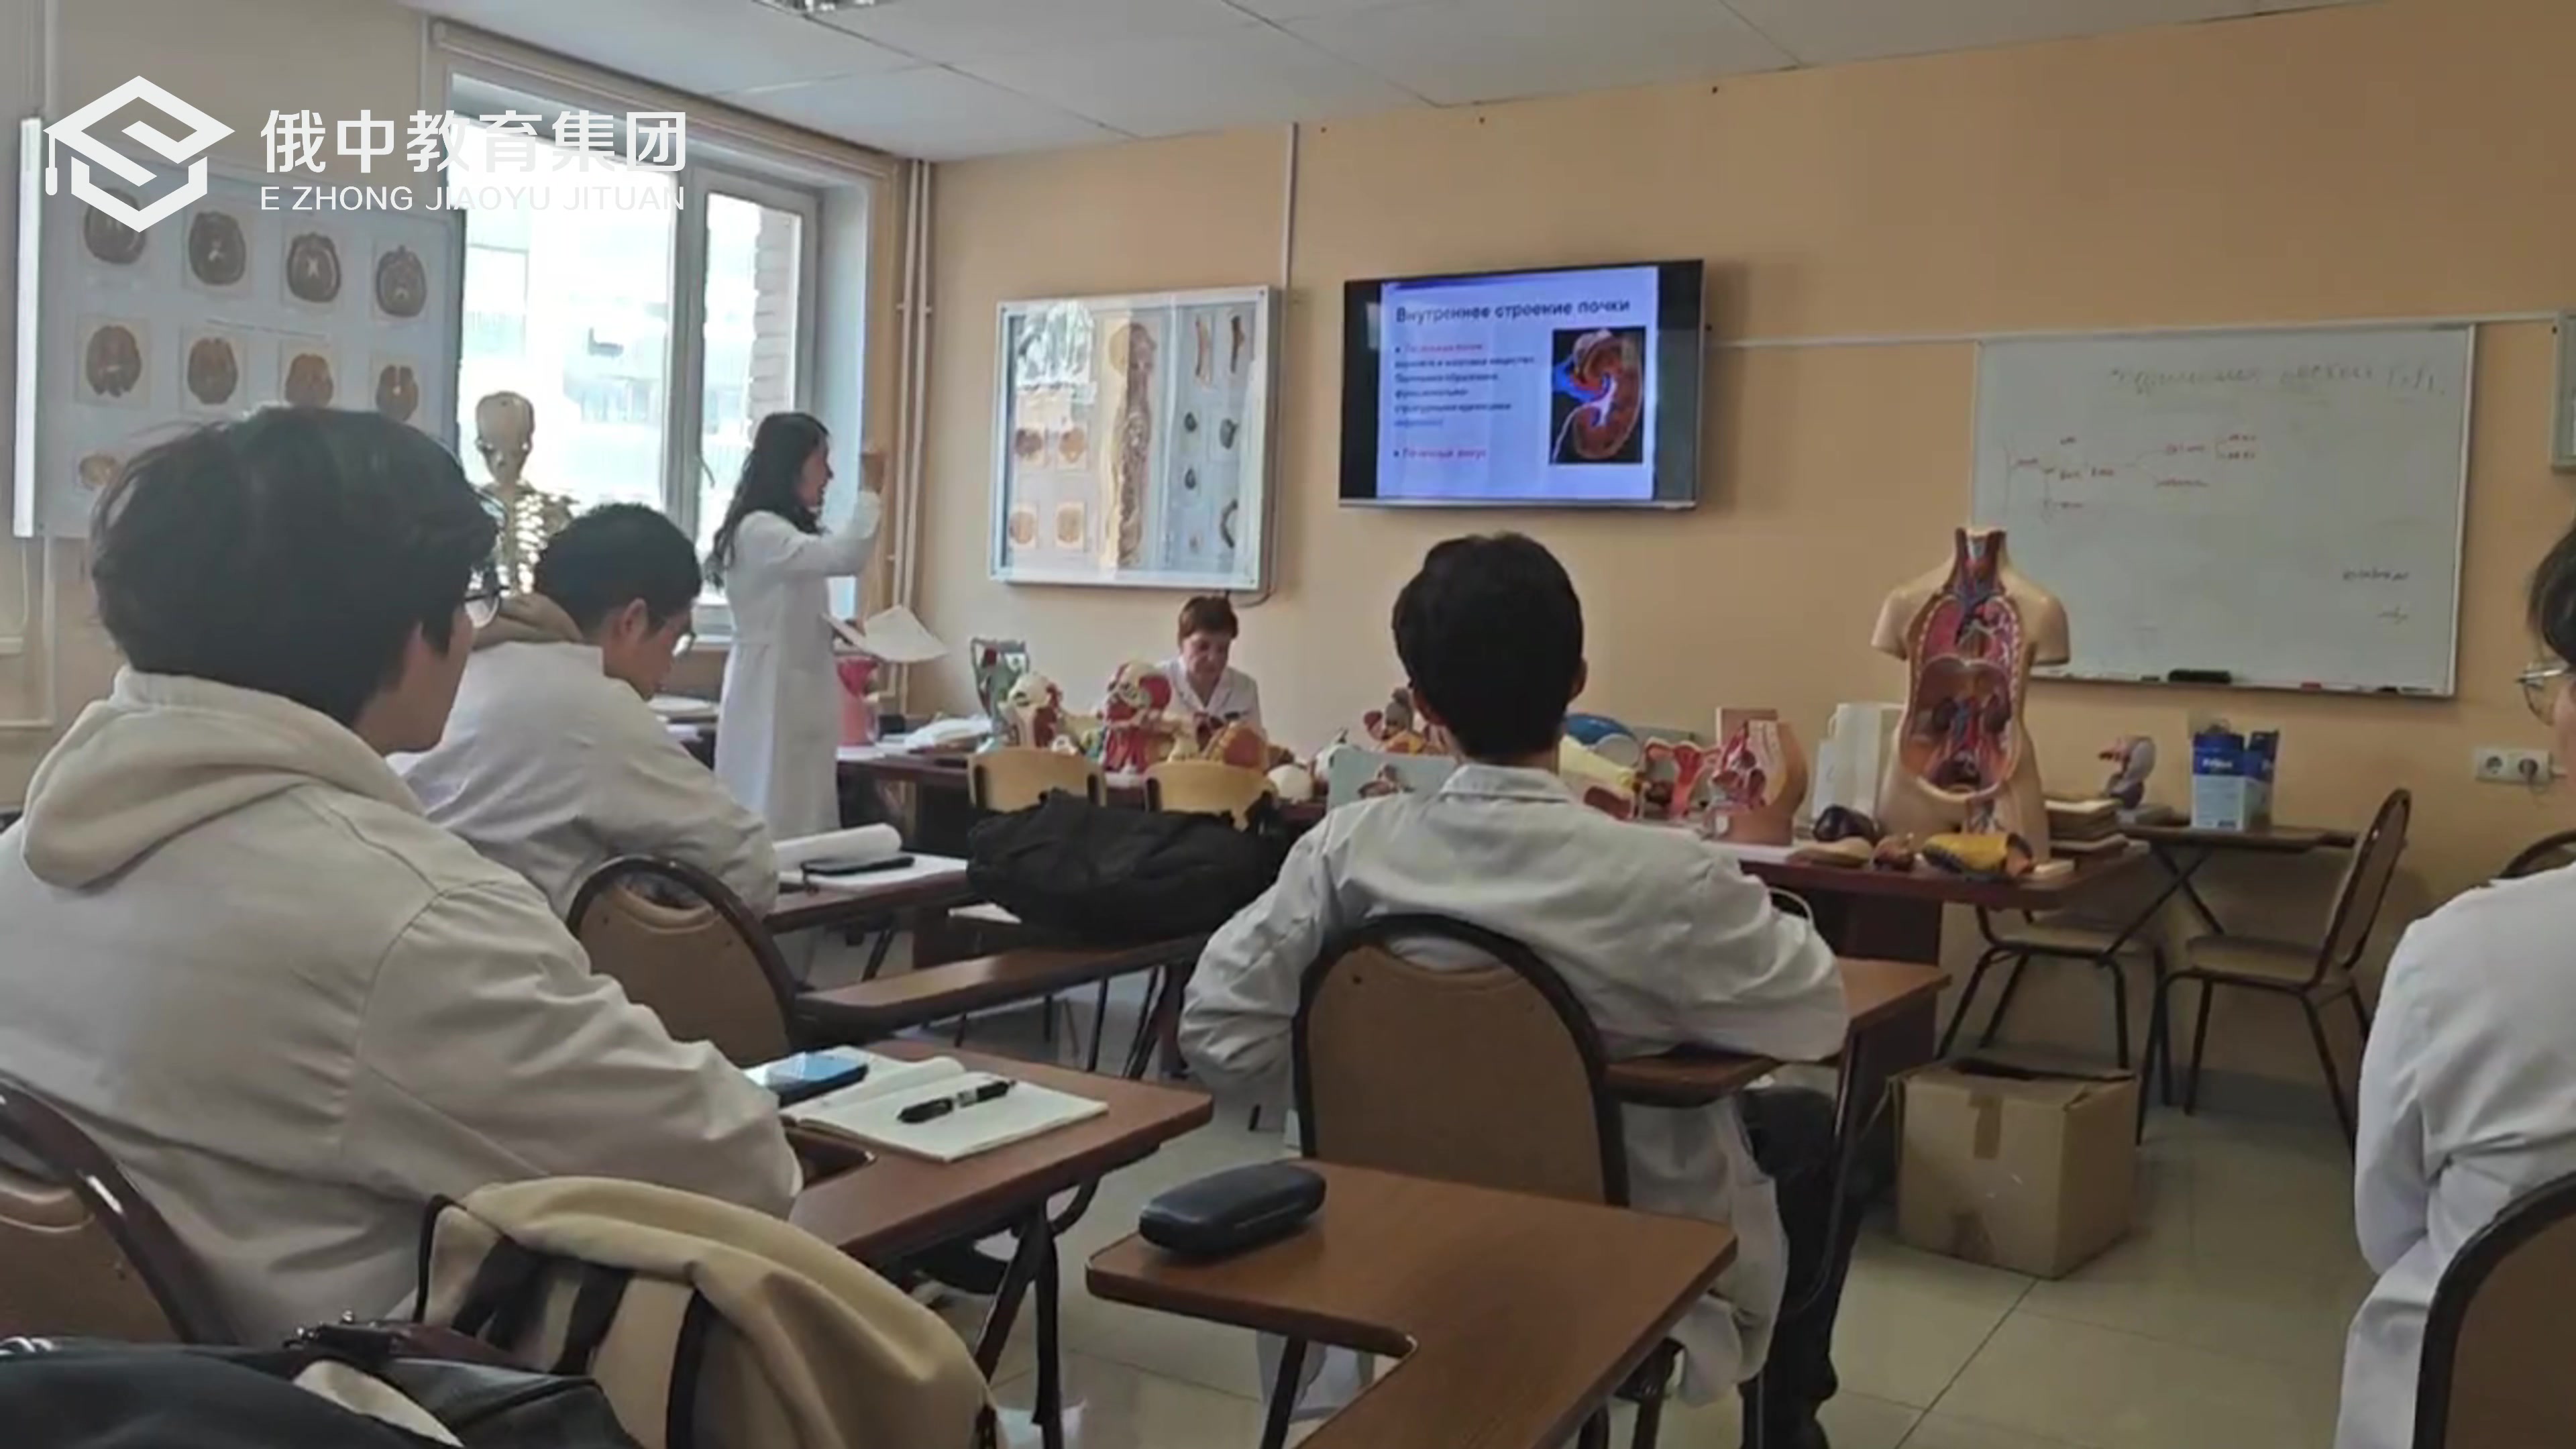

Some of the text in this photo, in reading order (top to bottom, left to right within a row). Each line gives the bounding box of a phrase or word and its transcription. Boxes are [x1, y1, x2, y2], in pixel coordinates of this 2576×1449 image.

[1396, 299, 1631, 325] Внутреннее строение почки
